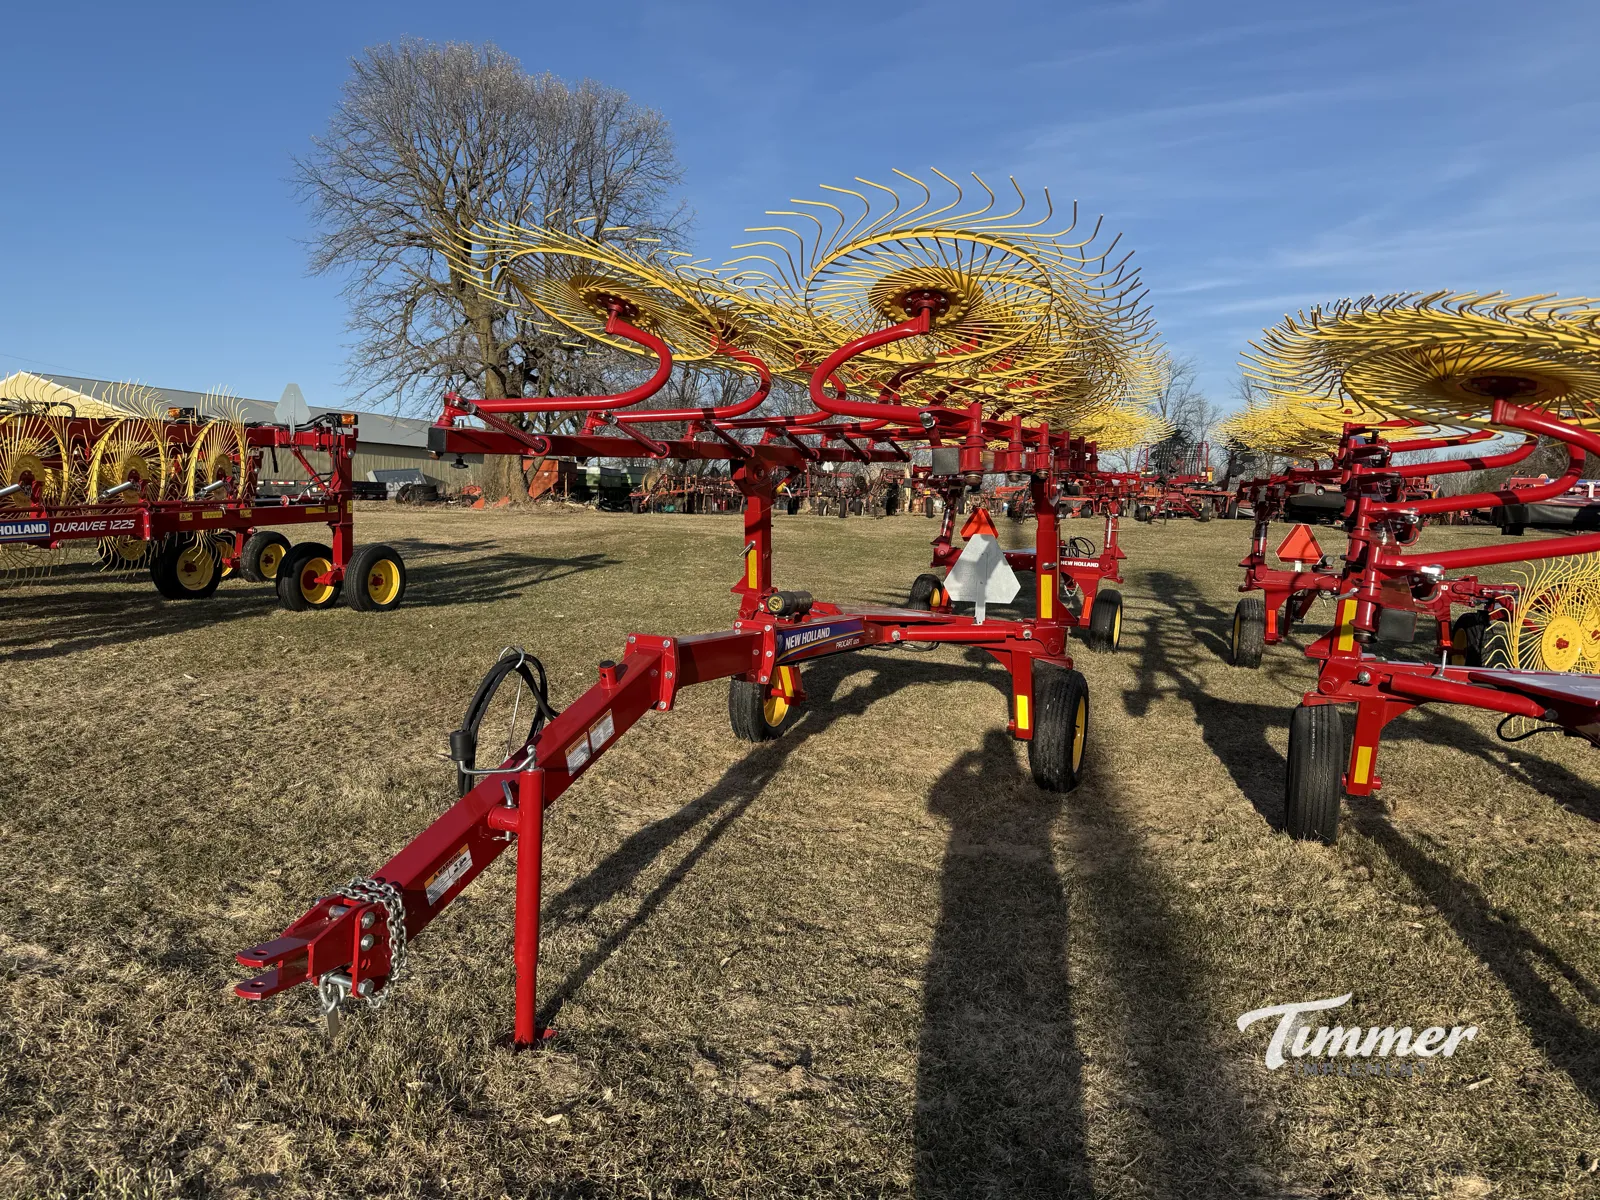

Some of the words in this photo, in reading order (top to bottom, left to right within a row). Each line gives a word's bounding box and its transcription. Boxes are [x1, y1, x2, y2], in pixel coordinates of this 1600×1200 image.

[53, 520, 107, 533] DURAVEE
[109, 519, 136, 530] 1225
[784, 634, 801, 650] NEW
[801, 627, 831, 644] HOLLAND
[437, 850, 461, 874] WARNING
